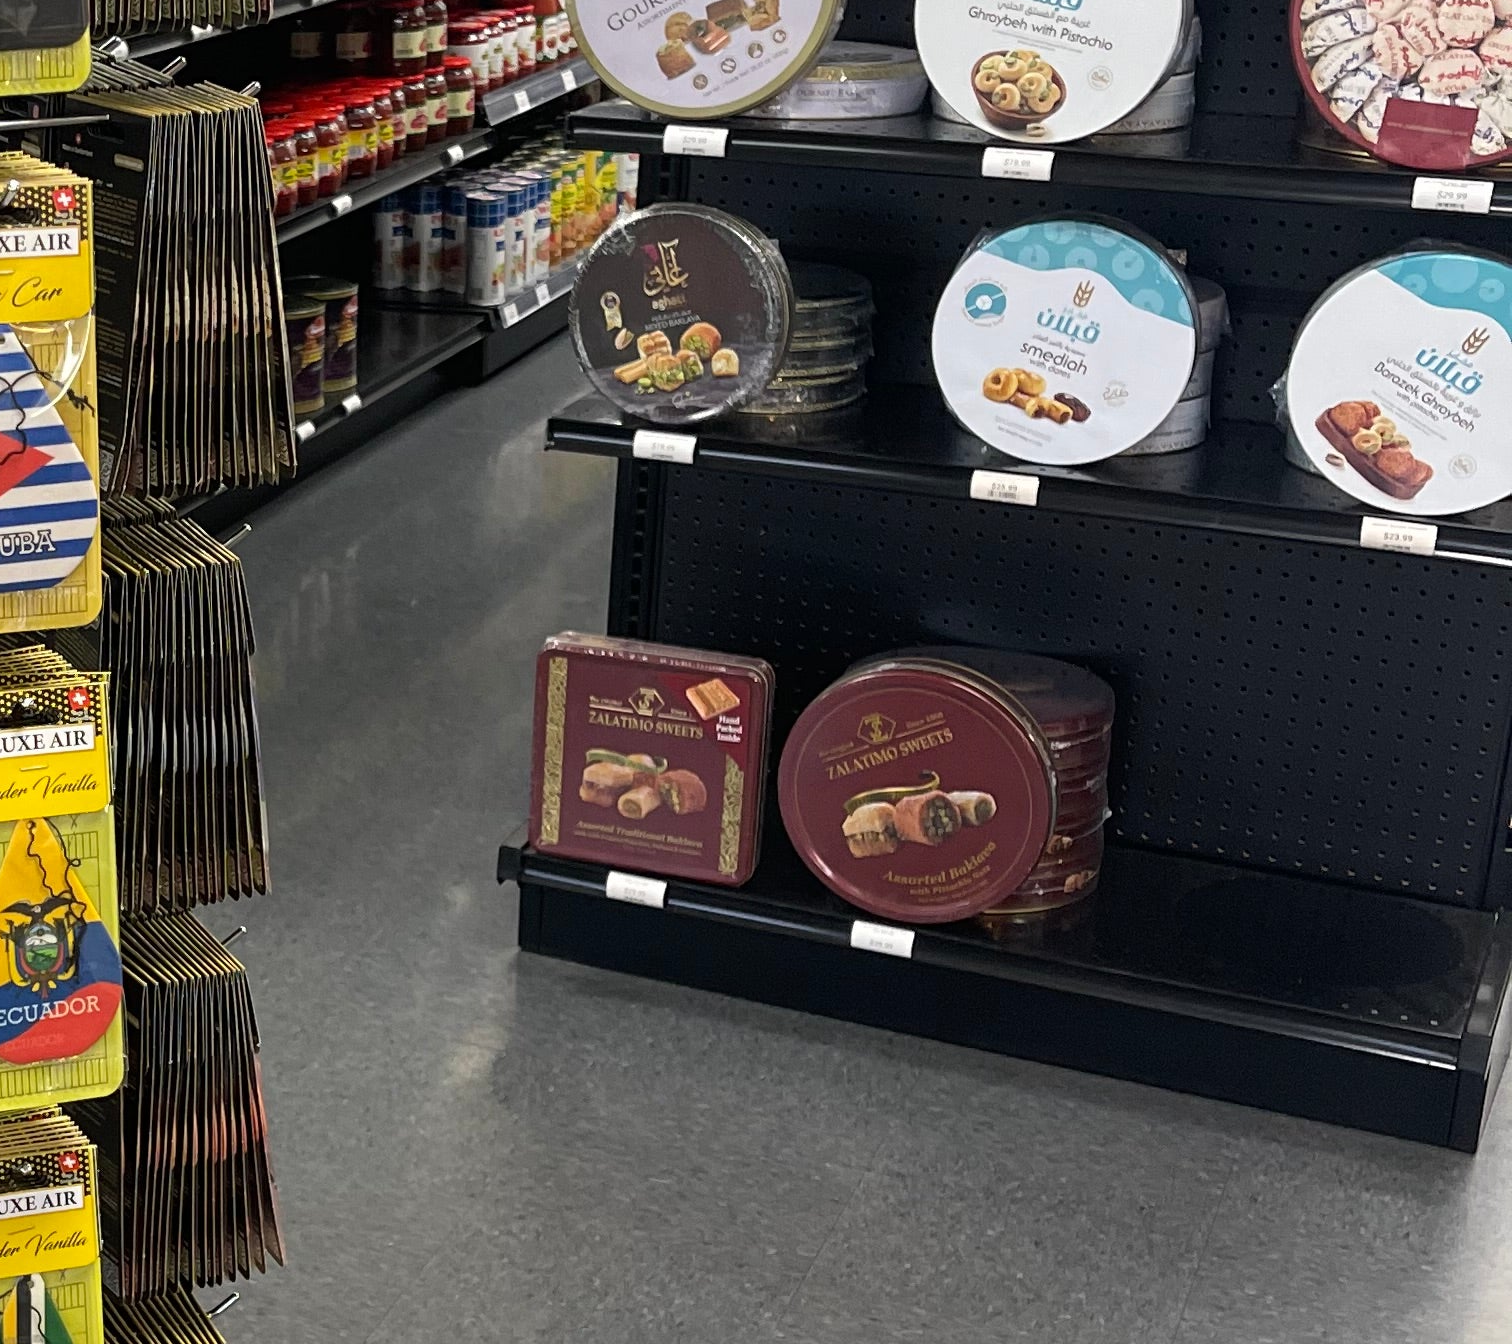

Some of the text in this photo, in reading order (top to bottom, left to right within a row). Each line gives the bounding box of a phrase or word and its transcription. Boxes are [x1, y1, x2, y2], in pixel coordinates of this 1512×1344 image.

[968, 6, 1028, 31] Ghraybeh
[1031, 23, 1057, 37] with
[1060, 28, 1113, 51] Pistachio
[31, 232, 72, 253] AIR
[13, 277, 63, 308] Car
[1037, 308, 1100, 344] قبلان
[1020, 341, 1087, 376] smediah
[1030, 358, 1047, 369] with
[1416, 348, 1483, 395] قبلان
[1374, 361, 1420, 400] Barazek
[1422, 392, 1475, 433] Ghraybeh
[1396, 391, 1411, 403] with
[589, 711, 703, 740] ZALATIMO SWEETS
[716, 724, 742, 734] Packed
[719, 716, 740, 725] Hand
[50, 730, 89, 751] AIR
[825, 746, 898, 780] ZALATIMO
[899, 727, 953, 756] SWEETS
[34, 774, 100, 799] Vanilla
[882, 841, 997, 885] Assorted Baklava
[42, 1190, 79, 1210] AIR
[26, 1230, 88, 1258] Vanilla
